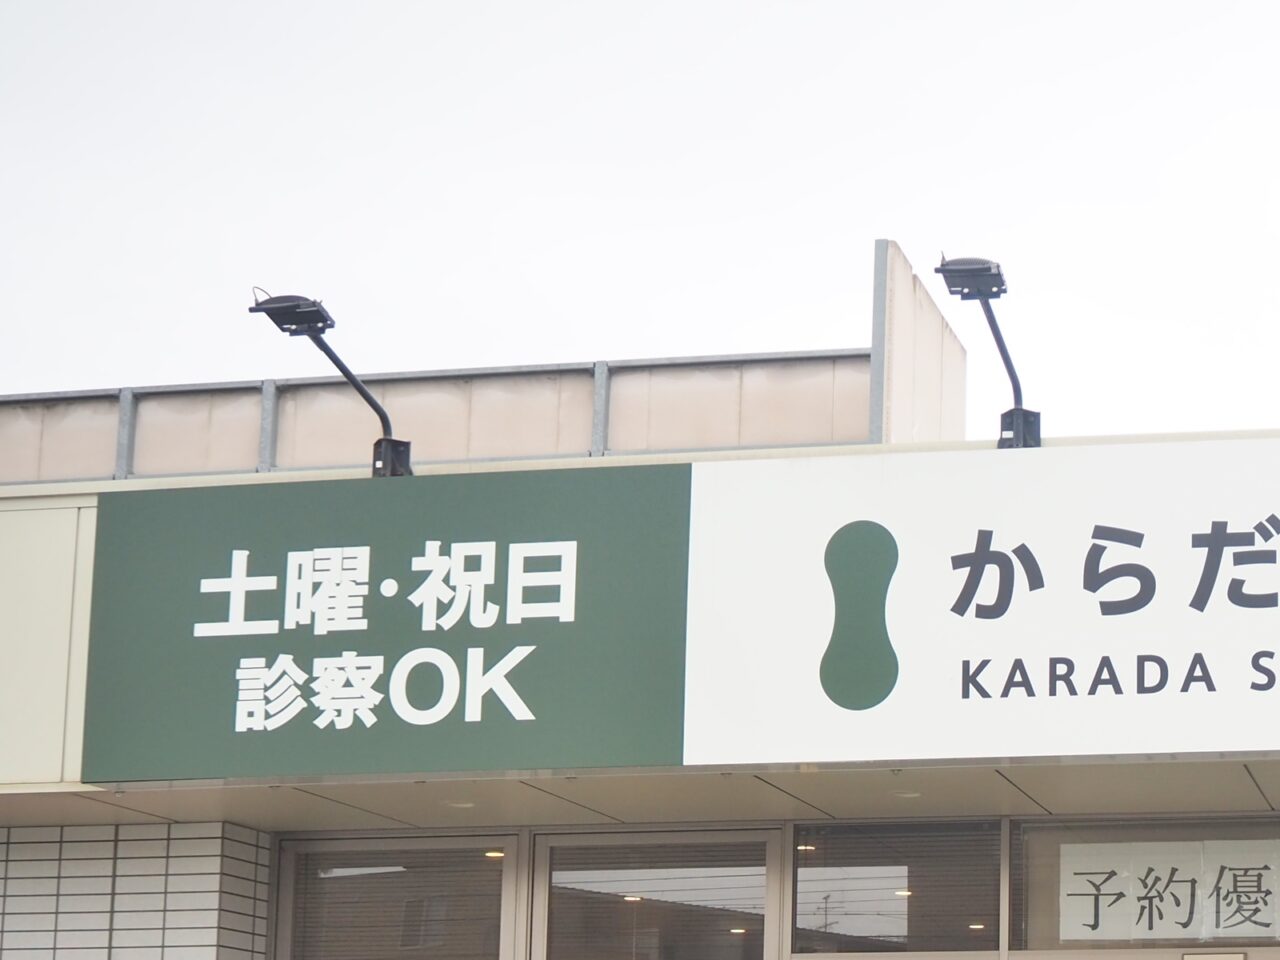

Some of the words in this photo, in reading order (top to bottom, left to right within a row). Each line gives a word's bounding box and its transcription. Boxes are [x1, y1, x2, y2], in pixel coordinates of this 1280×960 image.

[193, 540, 578, 637] 土曜・祝日
[235, 645, 537, 732] 診察OK
[961, 652, 1217, 699] KARADA
